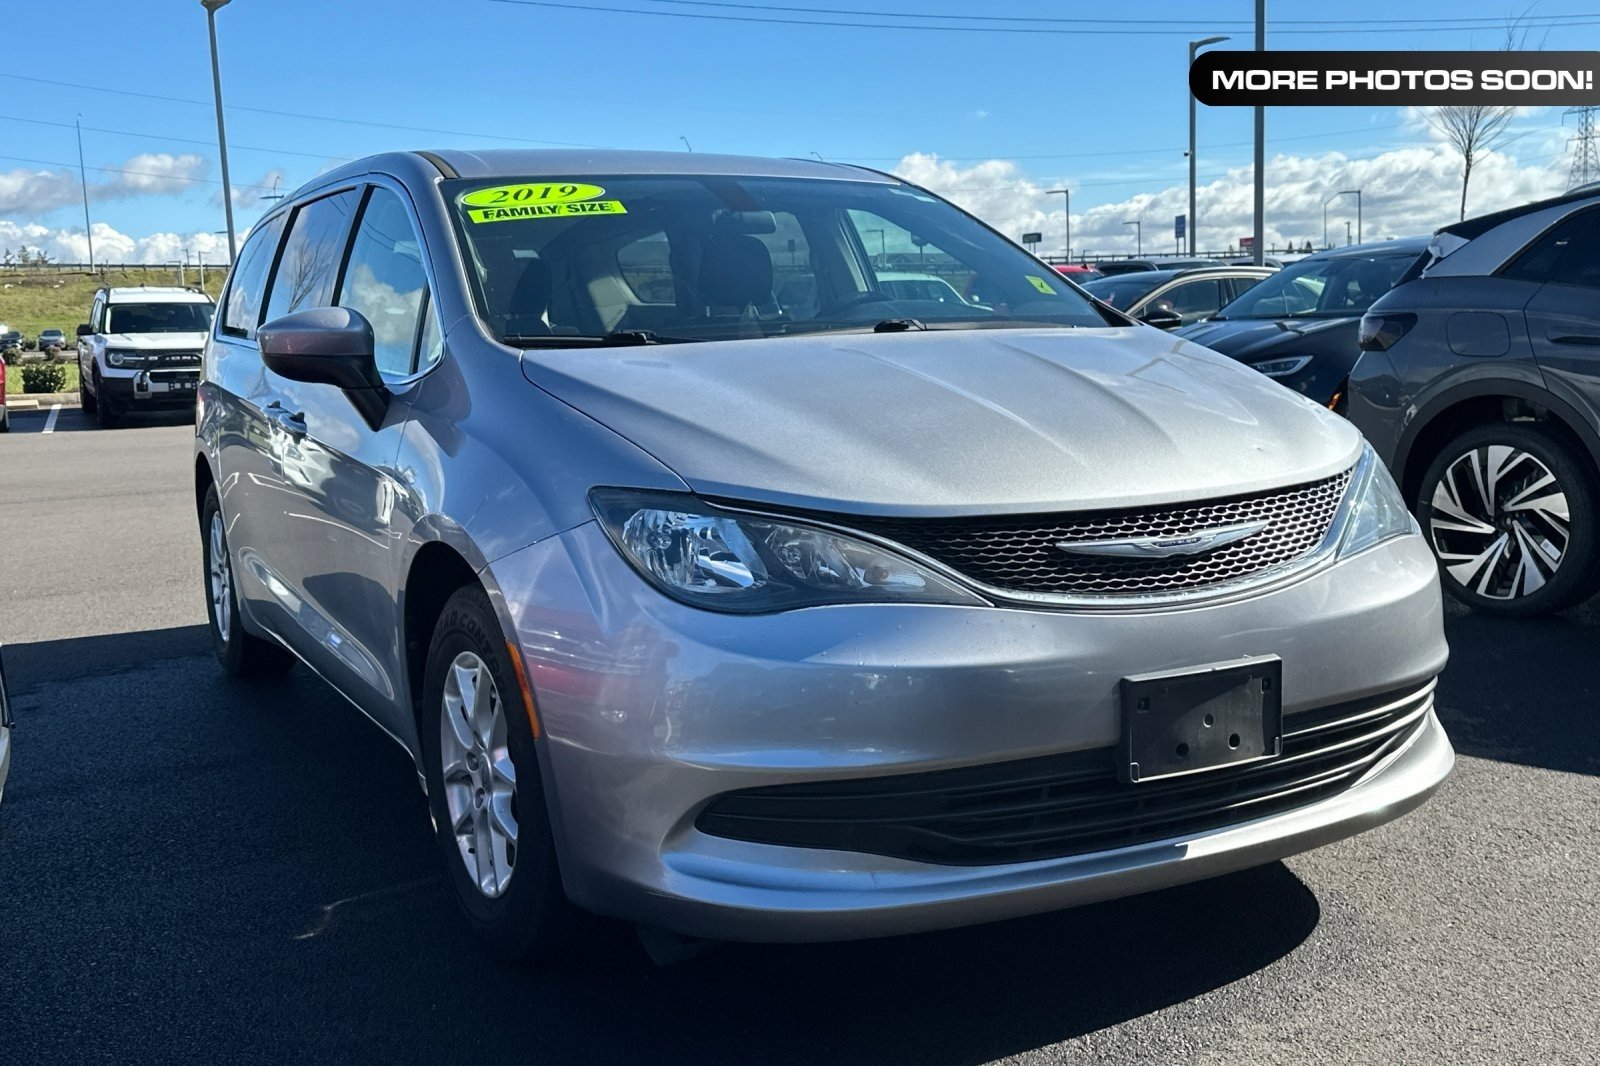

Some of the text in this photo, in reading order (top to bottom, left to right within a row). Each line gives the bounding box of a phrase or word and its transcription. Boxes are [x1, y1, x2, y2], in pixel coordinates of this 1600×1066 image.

[490, 185, 578, 203] 2019
[483, 202, 611, 220] FAMILY SIZE
